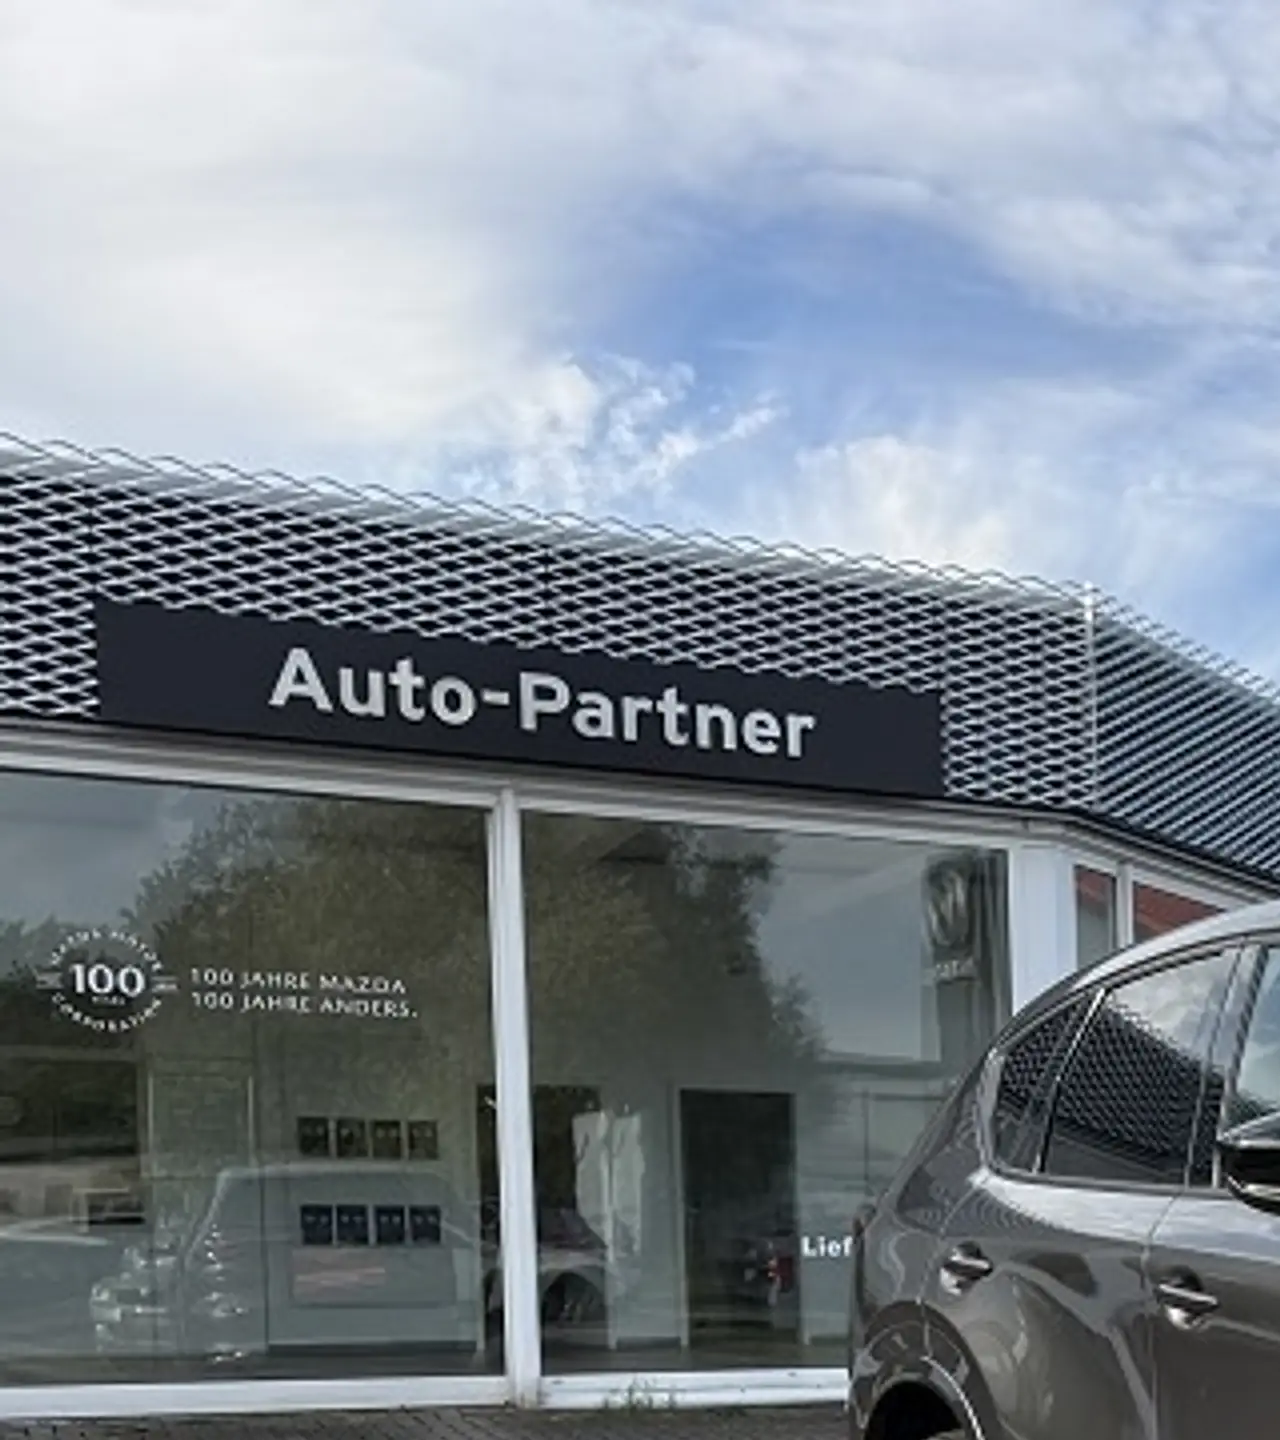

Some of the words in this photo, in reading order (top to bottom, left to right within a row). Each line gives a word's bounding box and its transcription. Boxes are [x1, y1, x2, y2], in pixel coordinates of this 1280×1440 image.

[268, 647, 816, 758] Auto-Partner
[68, 963, 146, 998] 100
[191, 968, 234, 986] 100
[240, 971, 310, 990] JAHRE
[319, 974, 406, 995] MAZDA
[191, 992, 234, 1010] 100
[240, 994, 310, 1014] JAHRE
[319, 999, 418, 1018] ANDERS.
